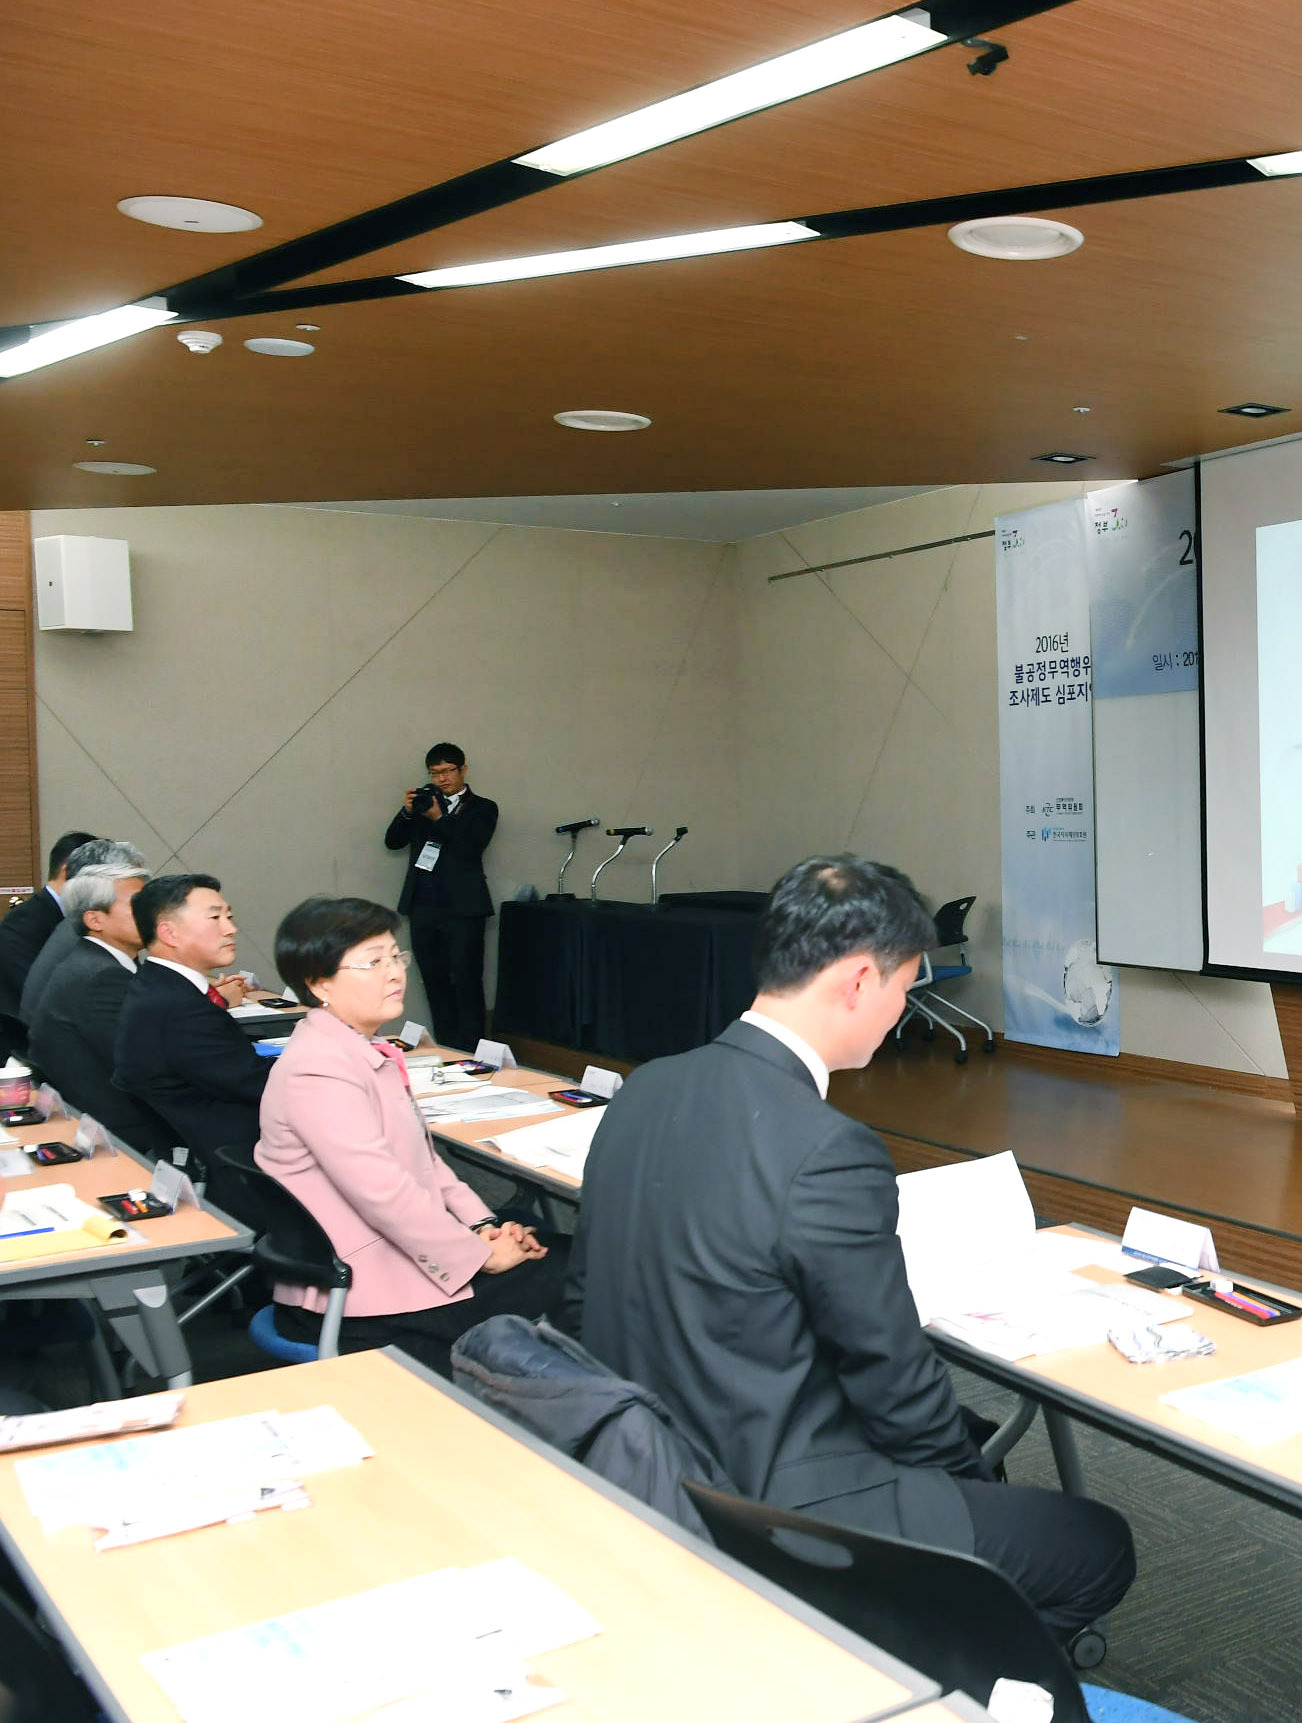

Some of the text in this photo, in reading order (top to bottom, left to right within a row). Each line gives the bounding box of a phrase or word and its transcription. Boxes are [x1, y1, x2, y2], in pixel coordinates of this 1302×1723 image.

[1035, 631, 1069, 653] 2016년
[1152, 651, 1173, 671] 일시
[1009, 681, 1091, 707] 조사제도 심포지
